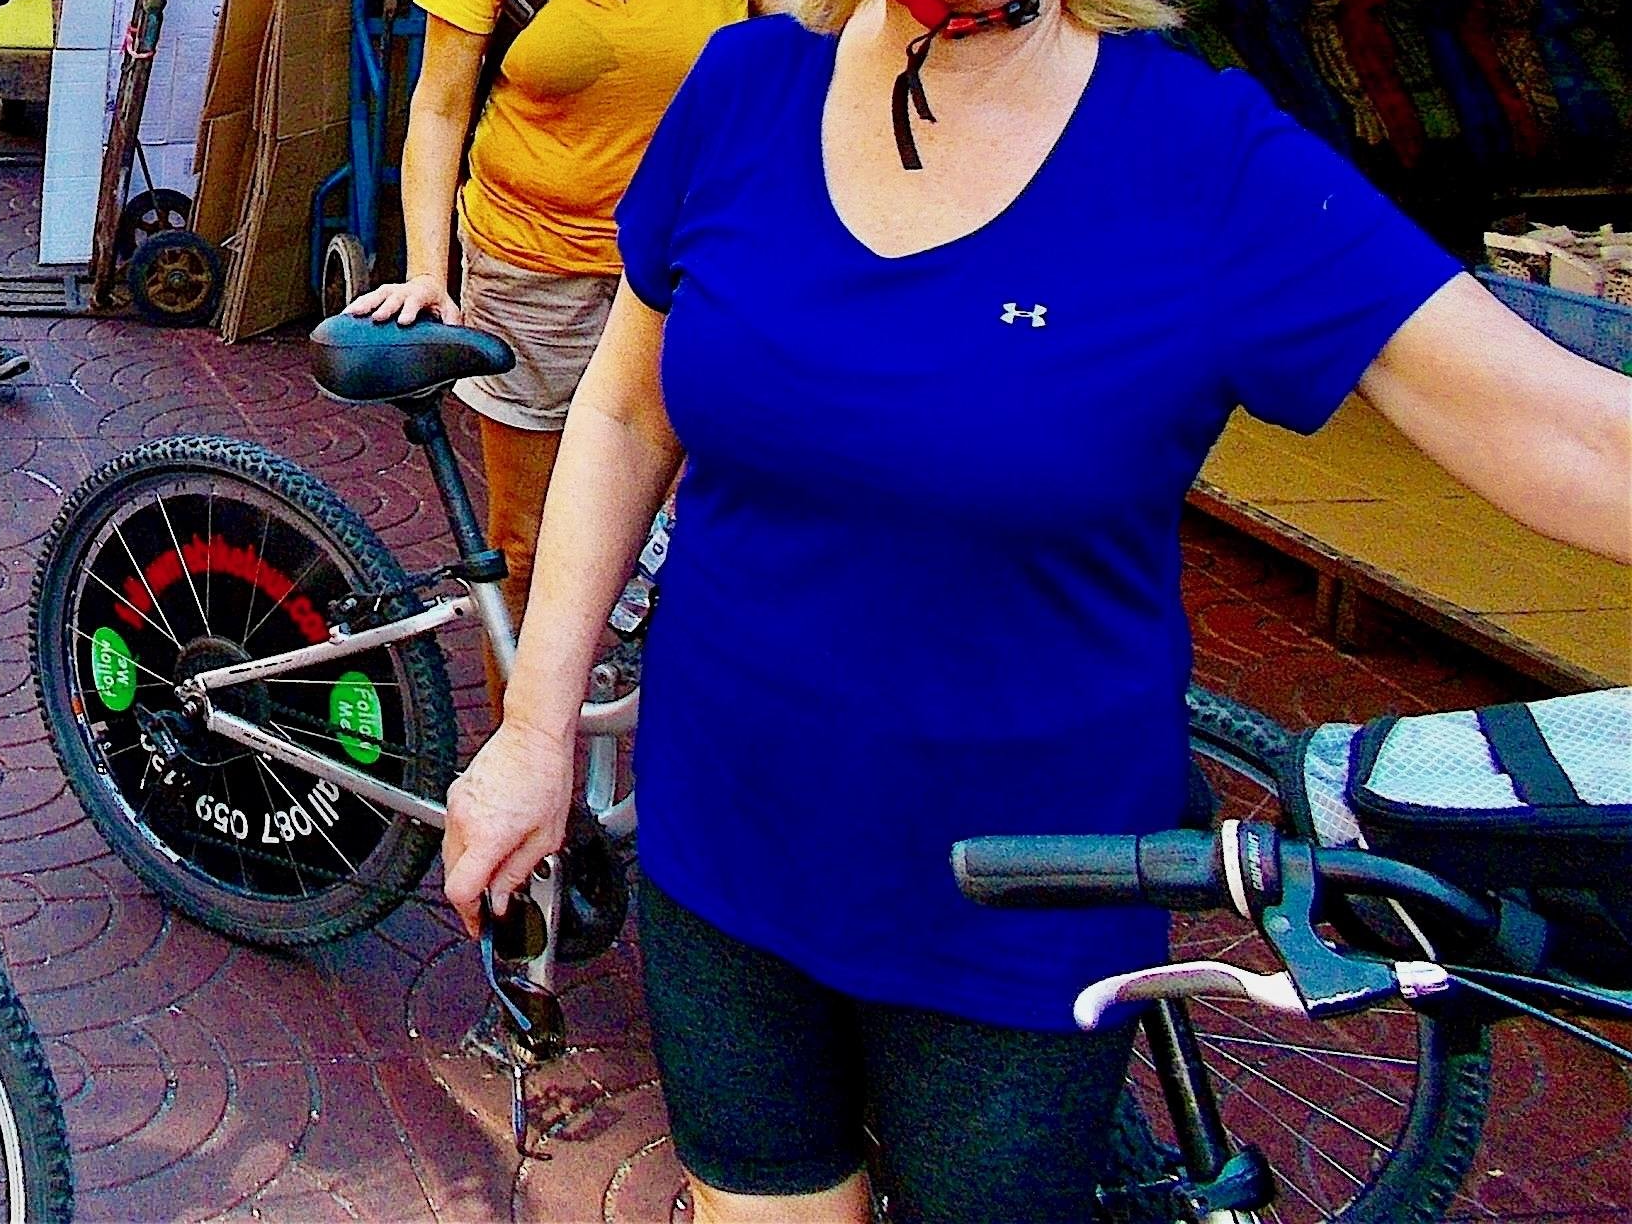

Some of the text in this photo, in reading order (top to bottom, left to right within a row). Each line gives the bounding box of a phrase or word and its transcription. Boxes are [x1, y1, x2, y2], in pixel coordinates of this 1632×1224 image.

[115, 657, 130, 686] Me
[337, 700, 354, 730] Me
[195, 794, 249, 840] 059
[261, 805, 313, 844] 087
